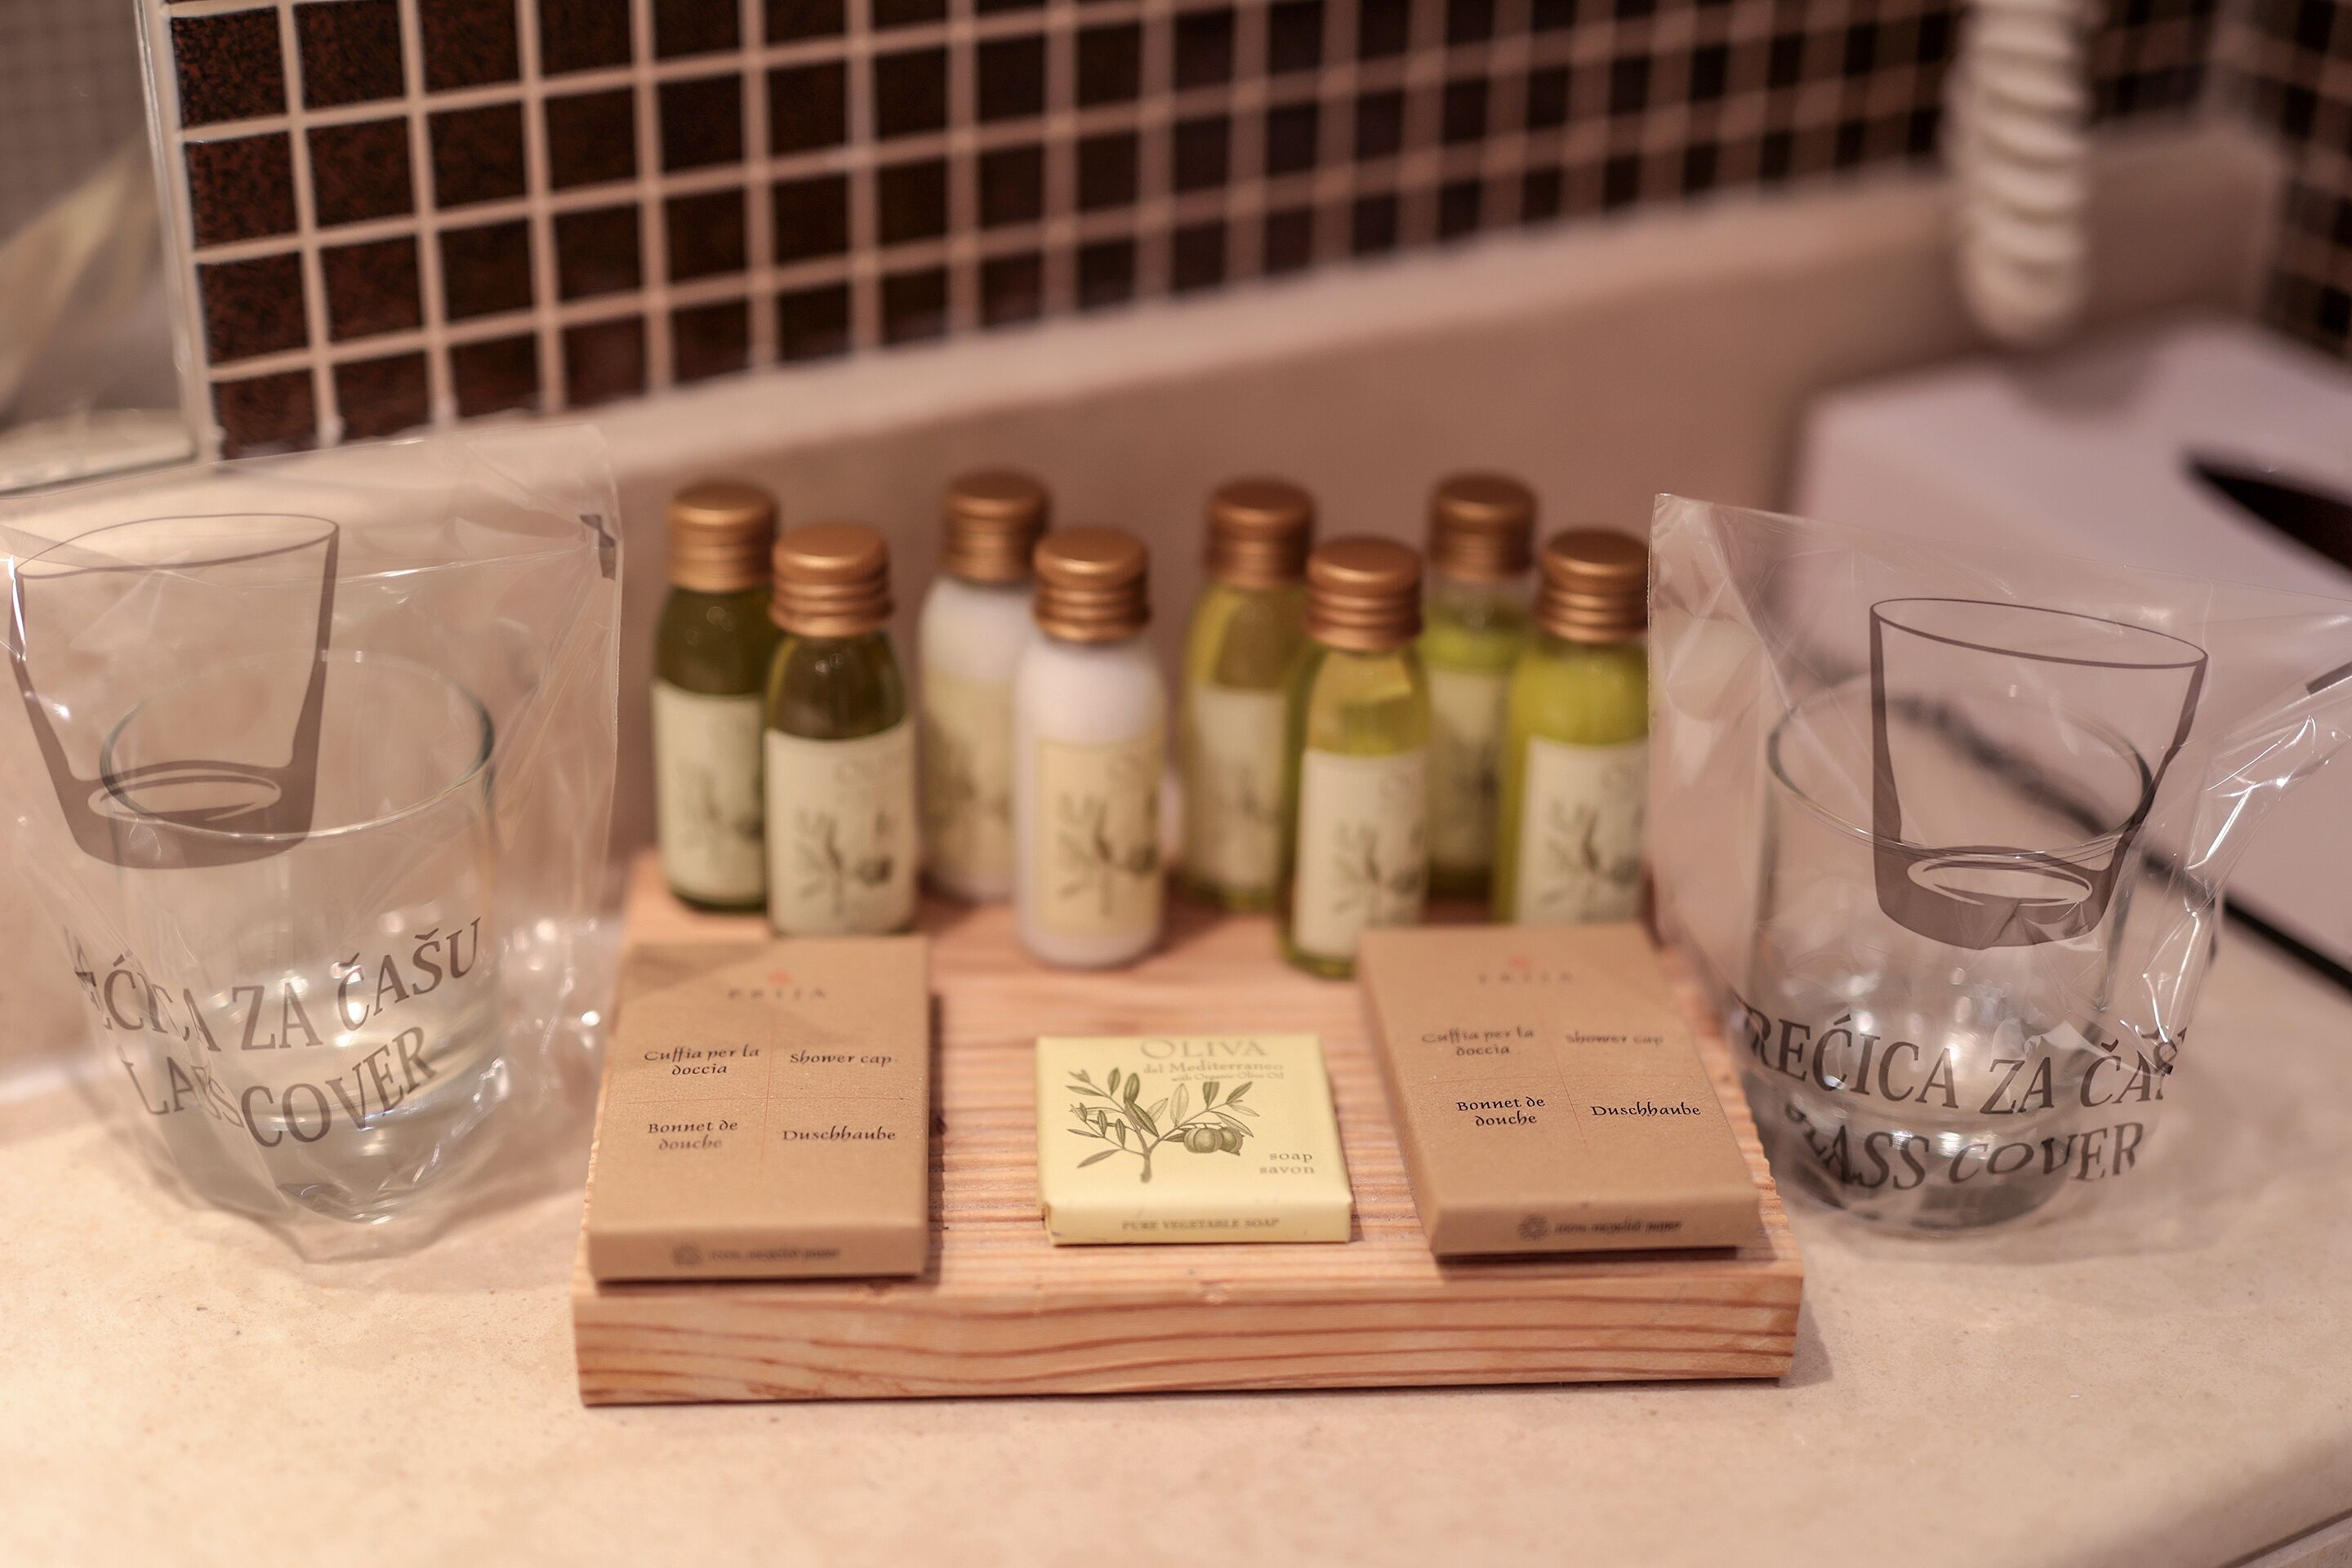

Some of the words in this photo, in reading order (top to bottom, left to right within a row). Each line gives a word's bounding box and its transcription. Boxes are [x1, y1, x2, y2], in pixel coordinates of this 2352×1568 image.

[232, 982, 323, 1051] ZA
[336, 917, 482, 1031] ČAŠU
[1422, 1027, 1478, 1045] Cuffia
[1517, 1025, 1535, 1039] la
[644, 1045, 702, 1065] Cuffia
[707, 1049, 737, 1061] per
[742, 1044, 760, 1058] la
[1140, 1038, 1268, 1059] OLIVA
[1456, 1045, 1510, 1056] doccia
[790, 1049, 855, 1064] Shower
[861, 1054, 893, 1067] cap
[672, 1062, 728, 1076] doccia
[1143, 1063, 1164, 1074] del
[1169, 1060, 1284, 1074] Mediterraneo
[1236, 1071, 1265, 1080] Olive
[1267, 1071, 1284, 1080] Oil
[241, 1027, 438, 1148] COVER
[1979, 1056, 2056, 1116] ZA
[1457, 1098, 1521, 1111] Bonnet
[1526, 1096, 1546, 1108] de
[1591, 1101, 1702, 1118] Duschhaube
[648, 1120, 713, 1134] Bonnet
[719, 1119, 738, 1132] de
[1475, 1111, 1538, 1126] douche
[782, 1125, 897, 1142] Duschhaube
[658, 1135, 724, 1151] douche
[1269, 1152, 1313, 1164] soap
[1949, 1121, 2145, 1184] COVER
[1259, 1165, 1315, 1175] savon
[1245, 1217, 1281, 1228] SOAP
